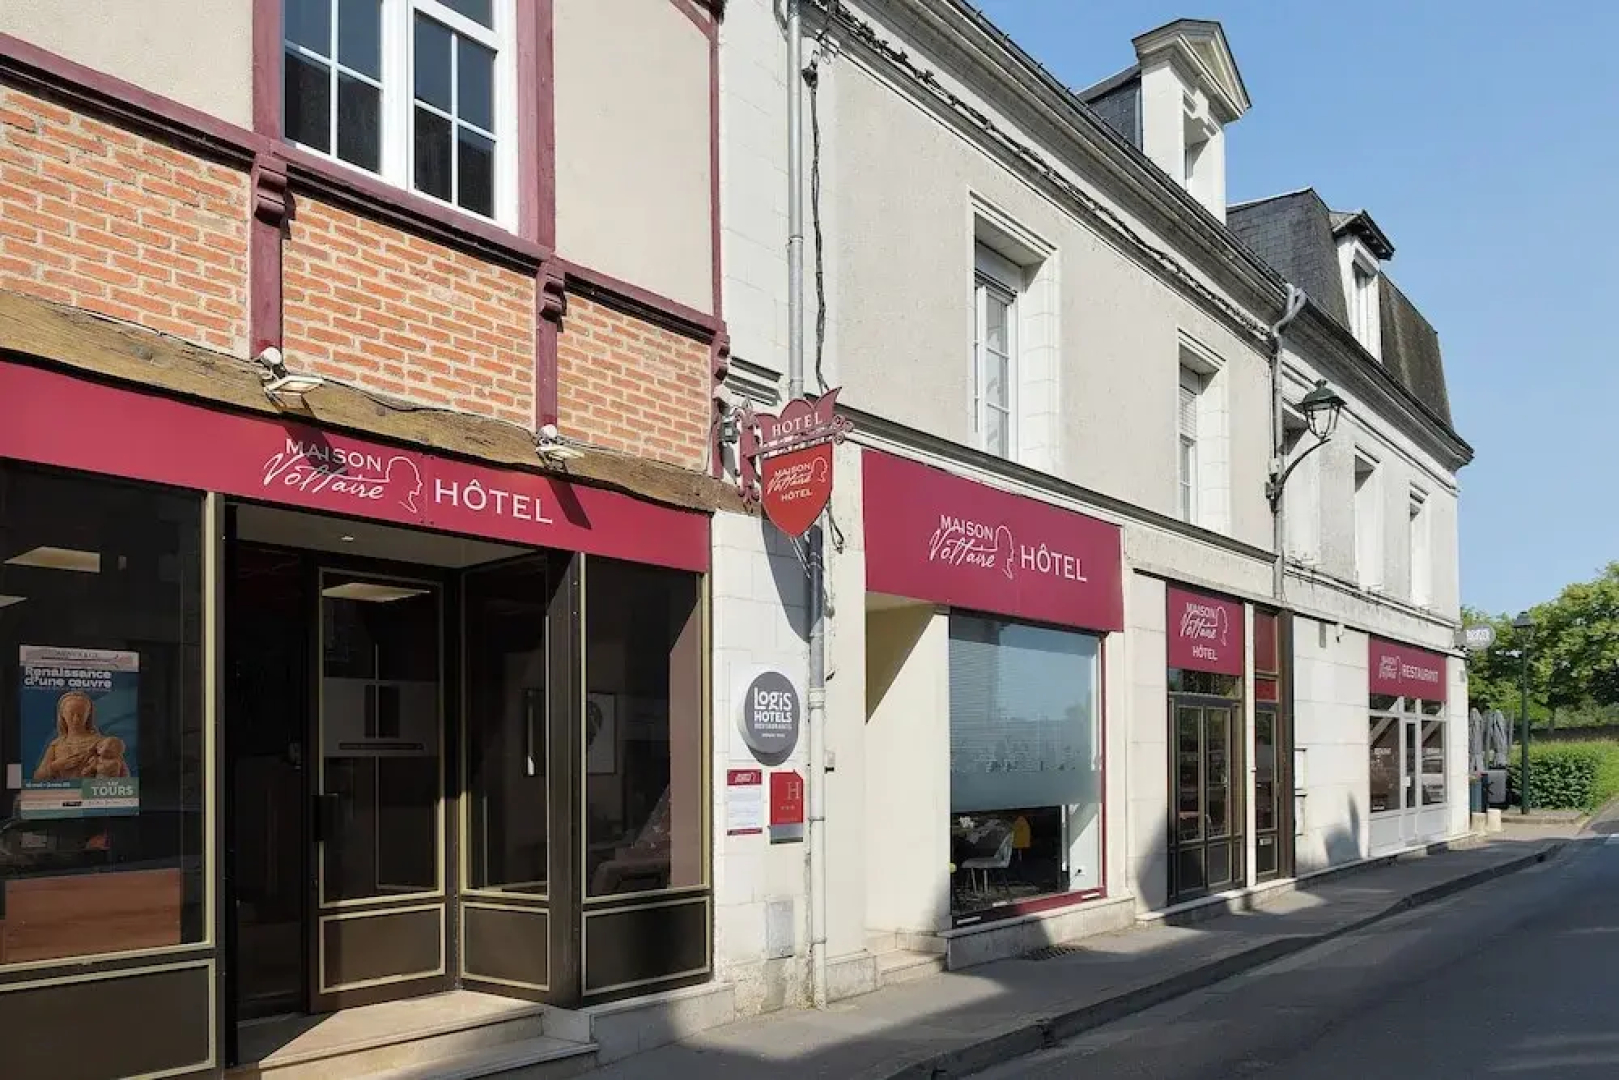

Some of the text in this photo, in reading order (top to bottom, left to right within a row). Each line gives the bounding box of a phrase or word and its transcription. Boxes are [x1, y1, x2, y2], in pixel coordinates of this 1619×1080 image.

[772, 412, 823, 437] HOTEL
[285, 438, 382, 472] MAISON
[262, 451, 385, 501] Voltaire
[775, 462, 811, 477] MAISON
[434, 478, 553, 524] HÔTEL
[940, 514, 994, 541] MAISON
[928, 528, 996, 568] Voltaire
[1019, 543, 1087, 582] HÔTEL
[1186, 602, 1216, 619] MAISON
[1192, 644, 1218, 661] HÔTEL
[24, 676, 65, 686] d'une
[25, 666, 111, 679] Renaissance
[1401, 664, 1439, 683] RESTAURANT
[753, 711, 792, 722] HOTELS
[91, 786, 134, 796] TOURS
[786, 781, 801, 800] H
